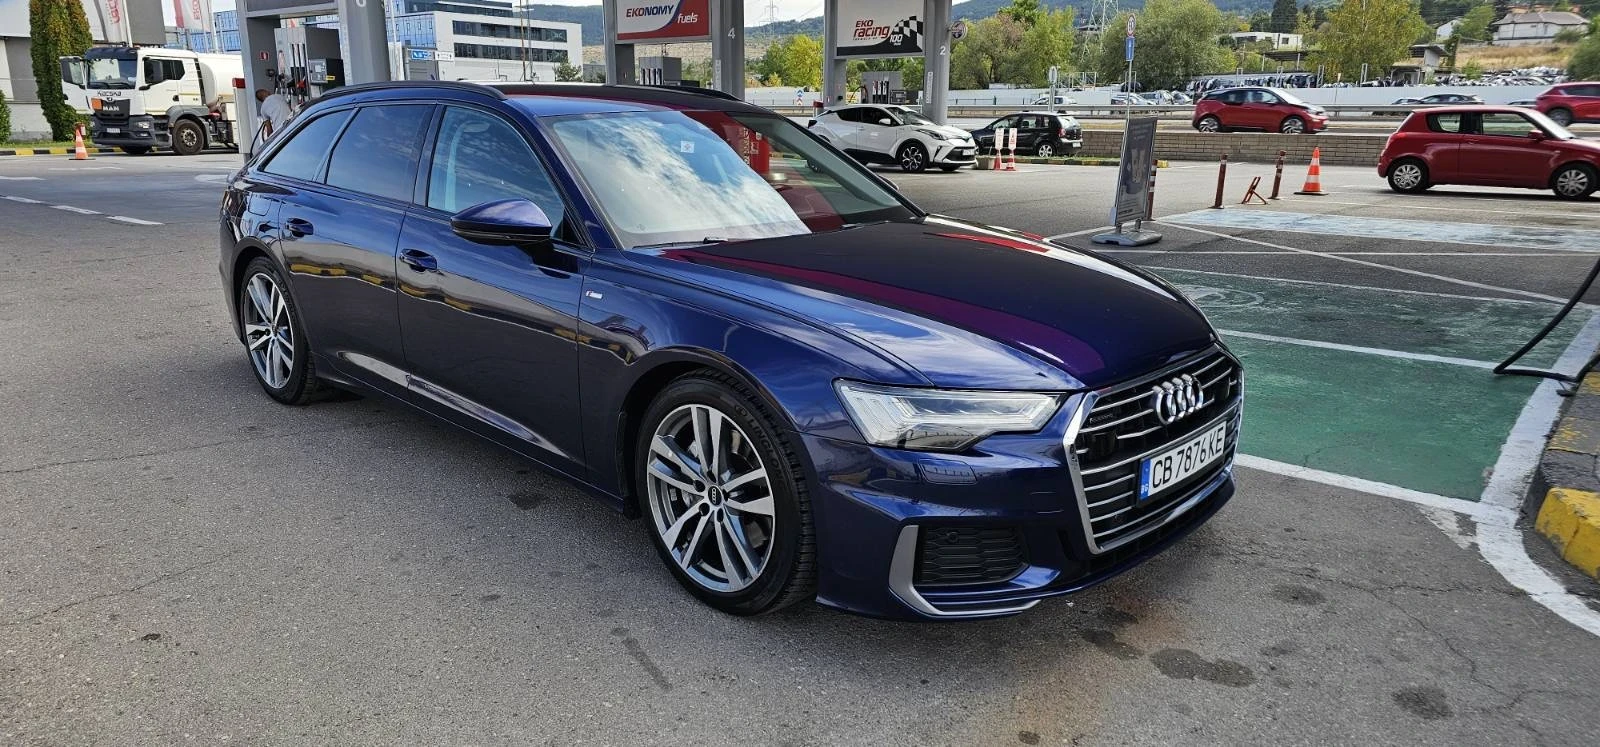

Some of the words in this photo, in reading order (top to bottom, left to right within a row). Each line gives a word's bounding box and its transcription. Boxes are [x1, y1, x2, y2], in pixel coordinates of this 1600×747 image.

[626, 5, 674, 18] EKONOMY
[677, 12, 699, 24] fuels
[855, 19, 874, 28] EKO
[727, 27, 736, 39] 4
[853, 25, 891, 39] racing
[889, 34, 903, 43] 100
[939, 45, 947, 56] 2
[1152, 455, 1173, 489] CB
[1175, 437, 1207, 479] 7876
[1208, 426, 1225, 460] KE
